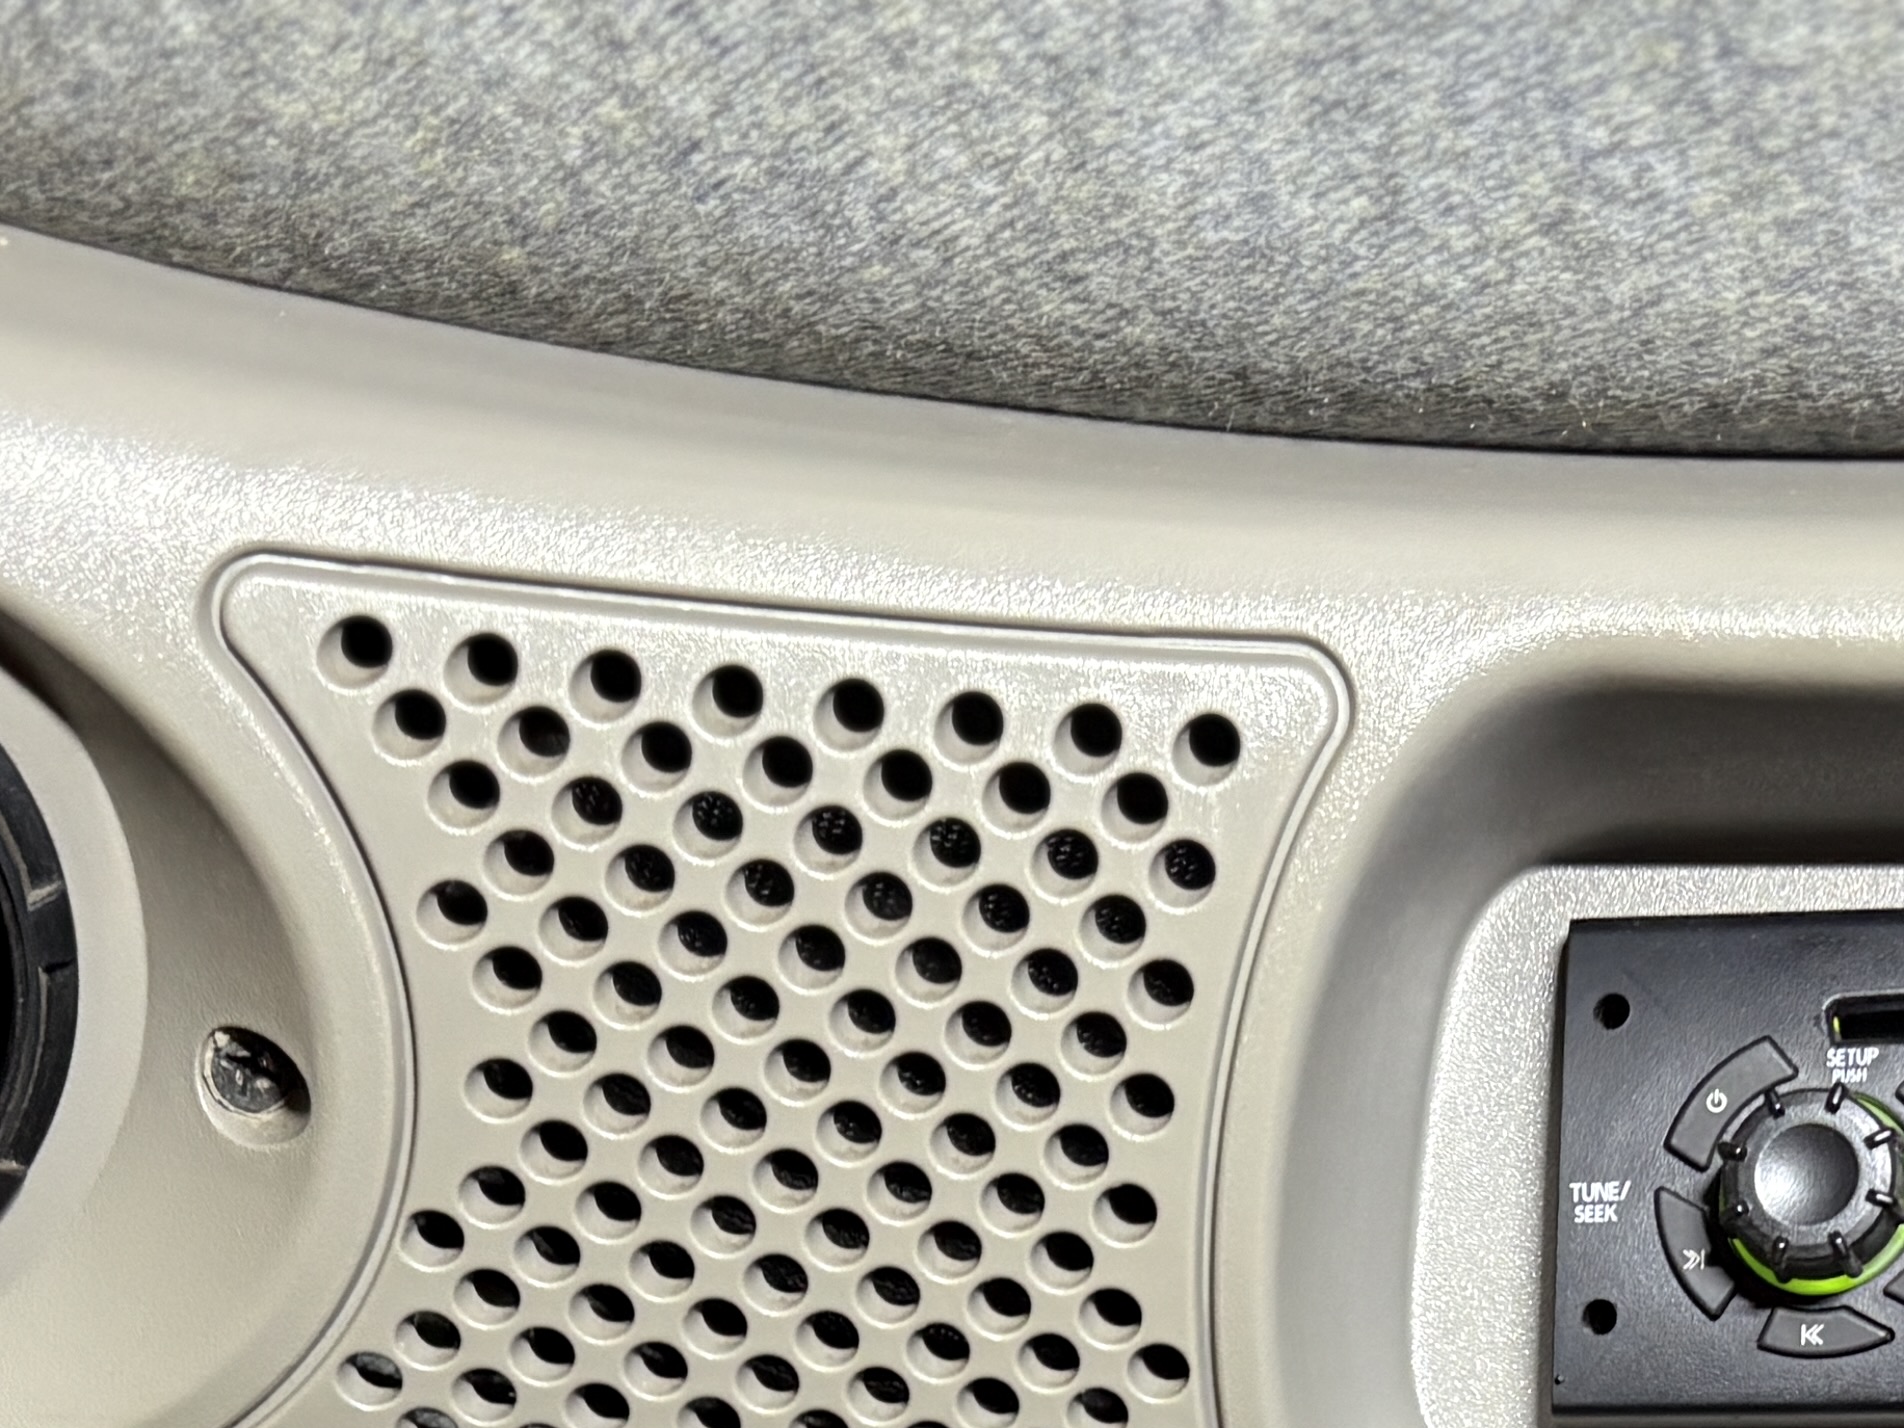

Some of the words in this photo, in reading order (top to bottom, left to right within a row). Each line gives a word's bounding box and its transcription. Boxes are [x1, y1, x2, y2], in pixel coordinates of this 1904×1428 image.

[1826, 1047, 1880, 1068] SETUP
[1831, 1067, 1868, 1084] PUSH
[1569, 1181, 1631, 1203] TUNE/
[1574, 1204, 1618, 1223] SEEK
